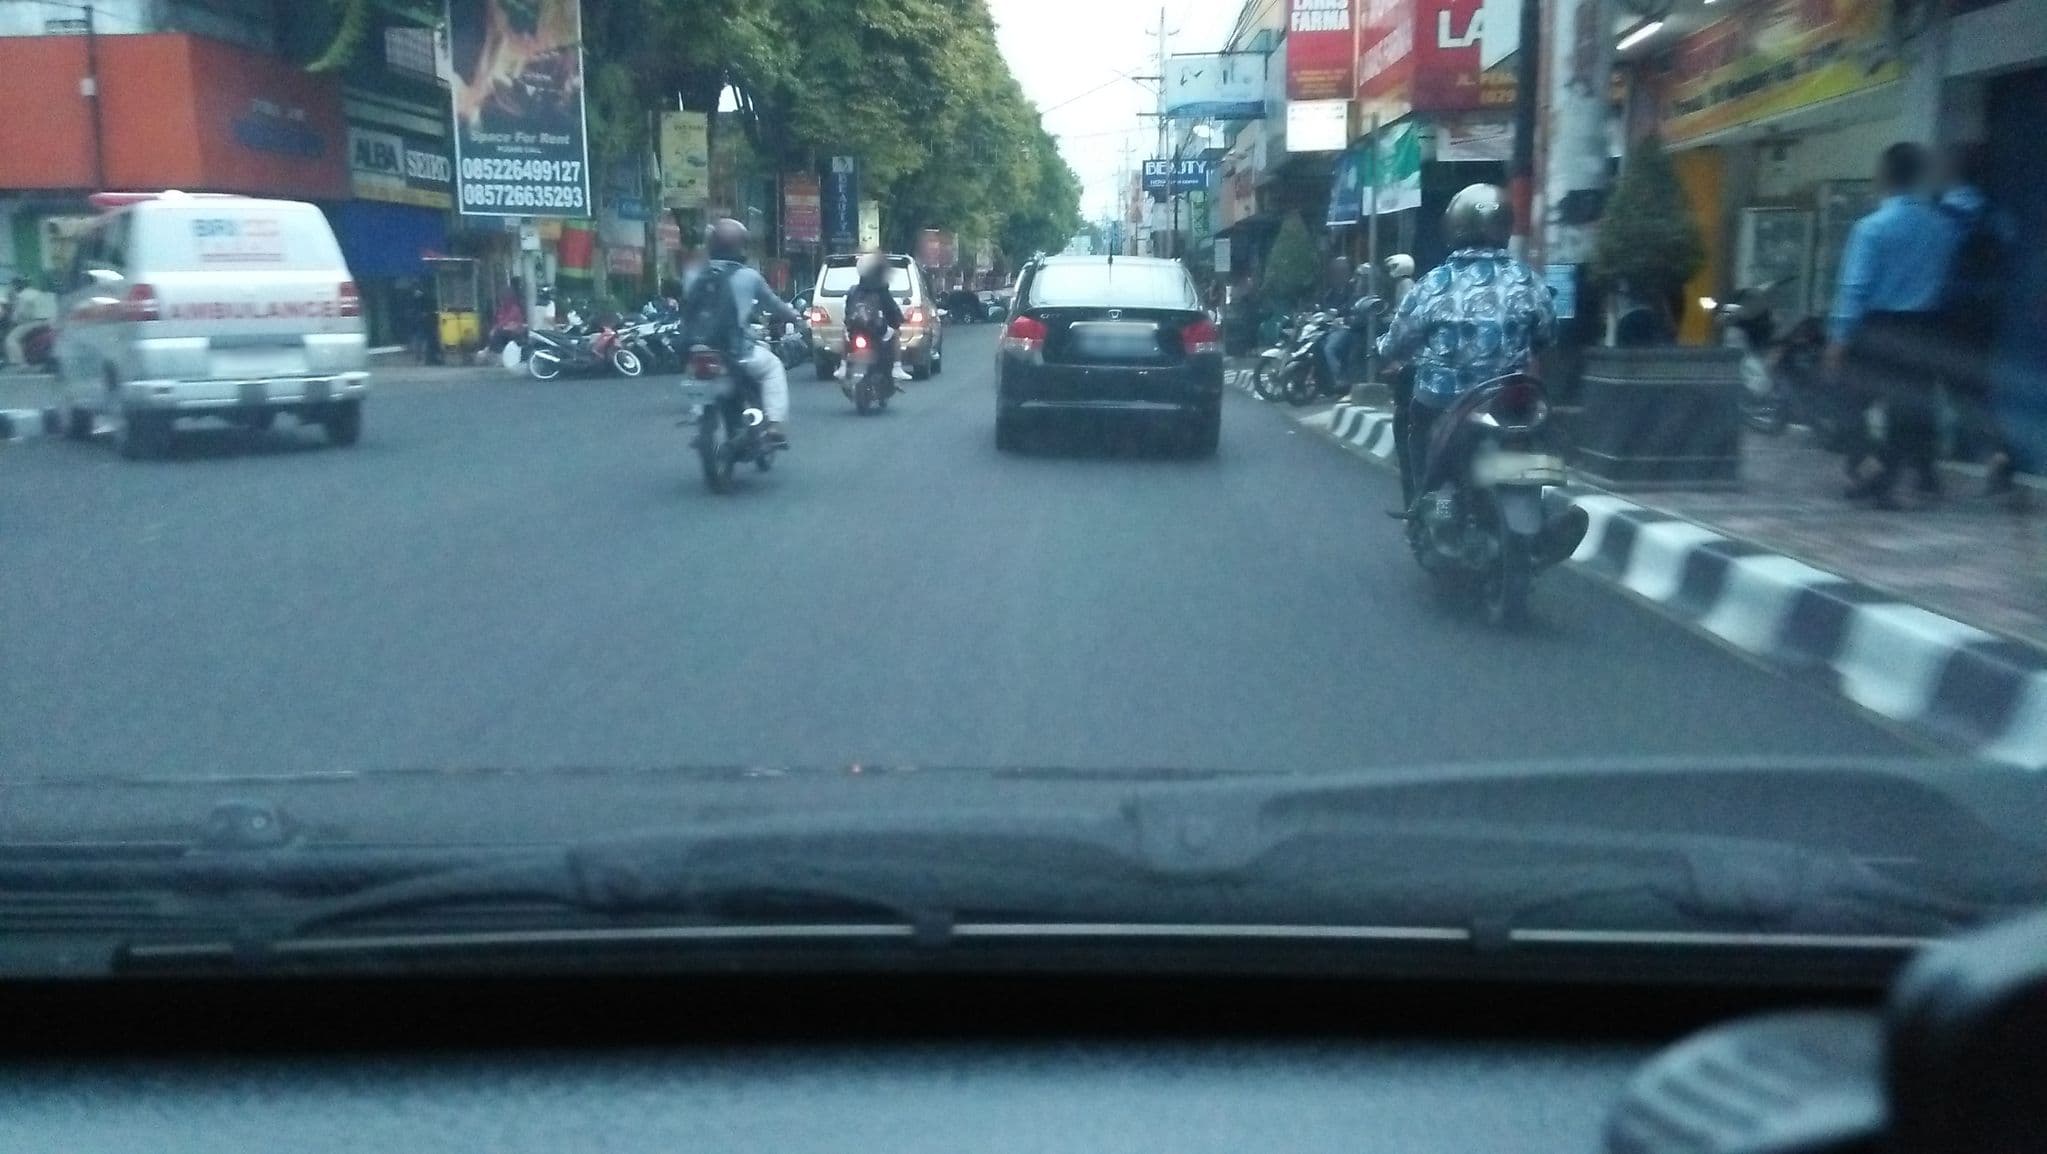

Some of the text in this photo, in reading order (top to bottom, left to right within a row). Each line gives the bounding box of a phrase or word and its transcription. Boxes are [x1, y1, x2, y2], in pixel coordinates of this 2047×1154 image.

[1291, 9, 1349, 31] FARMA
[471, 131, 570, 144] Space For Rent
[356, 137, 399, 171] ALBA
[407, 149, 451, 183] SEIKO
[462, 158, 580, 182] 085226499127
[463, 183, 583, 207] 085726635293
[169, 301, 337, 319] AMBULANCE
